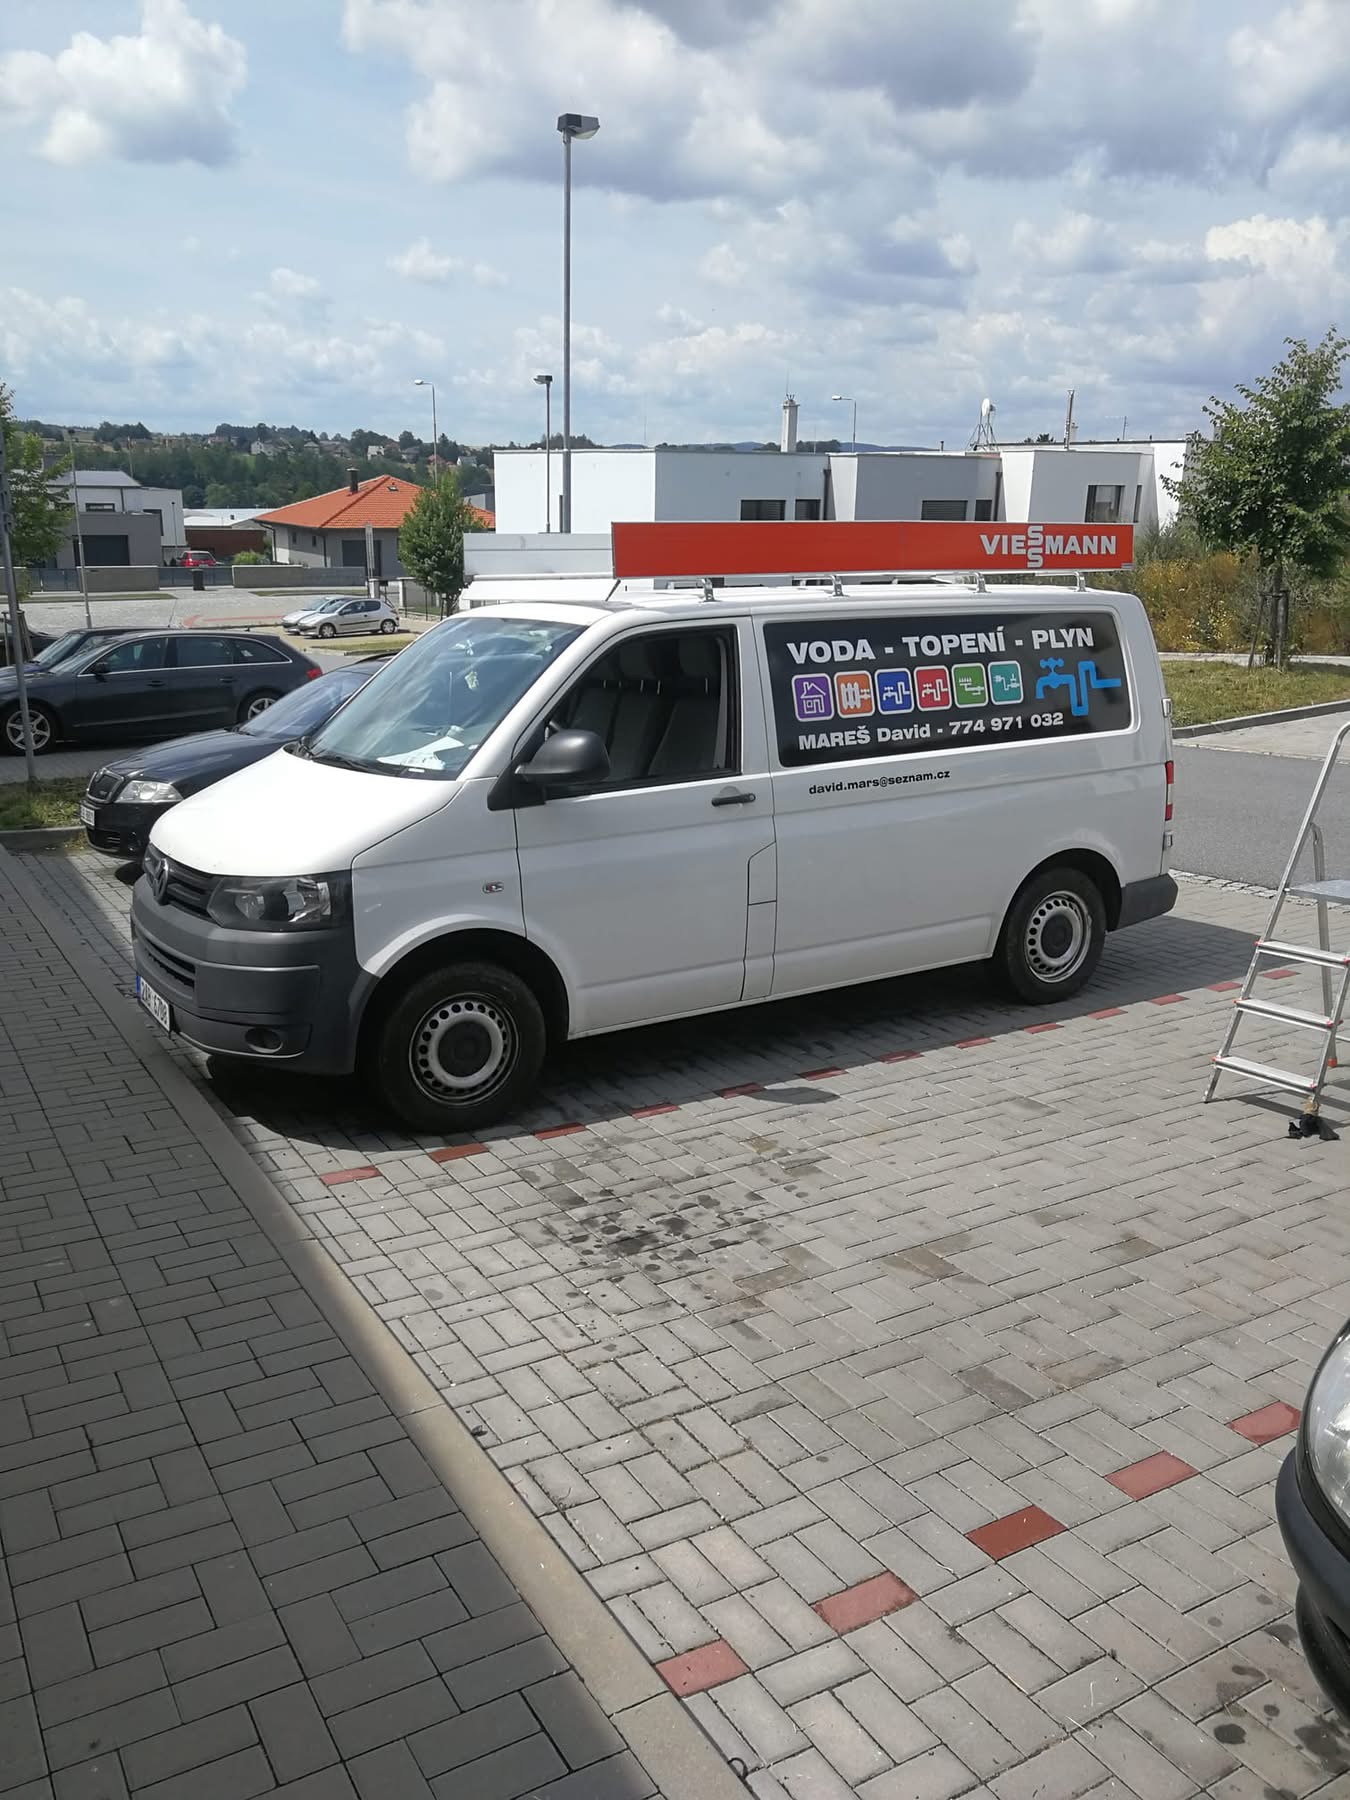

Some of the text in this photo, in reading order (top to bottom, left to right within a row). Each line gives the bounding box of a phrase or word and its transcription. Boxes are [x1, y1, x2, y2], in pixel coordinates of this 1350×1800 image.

[979, 525, 1116, 568] VIESSMANN
[787, 639, 877, 665] VODA
[902, 626, 1006, 657] TOPENÍ
[1032, 627, 1095, 650] PLYN
[798, 725, 871, 750] MAREŠ
[877, 723, 931, 743] David
[949, 718, 986, 735] 774
[991, 715, 1023, 731] 971
[1030, 712, 1064, 728] 032
[808, 770, 951, 795] david.mars@seznam.cz
